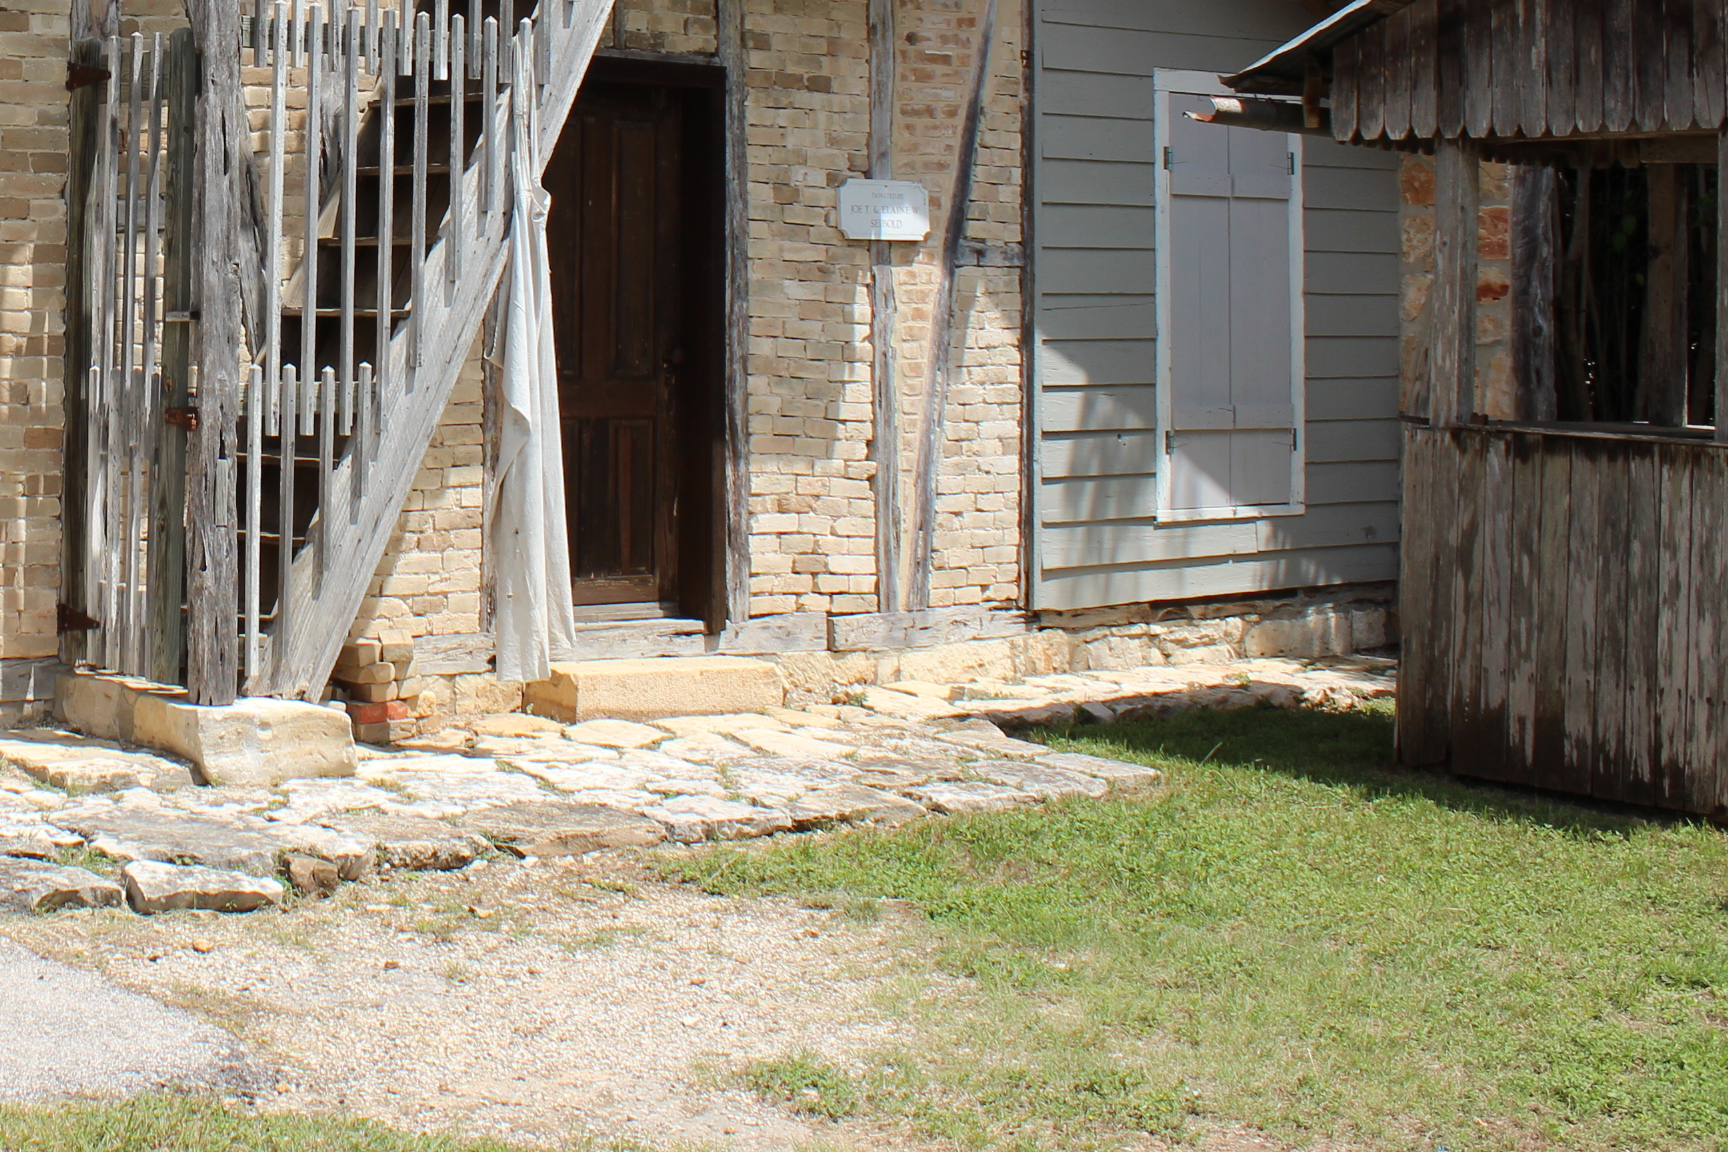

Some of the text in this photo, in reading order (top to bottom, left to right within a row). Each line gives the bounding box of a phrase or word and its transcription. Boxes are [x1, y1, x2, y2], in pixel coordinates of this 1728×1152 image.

[850, 205, 862, 214] JOE
[873, 205, 880, 214] &
[882, 205, 910, 215] ELAINE
